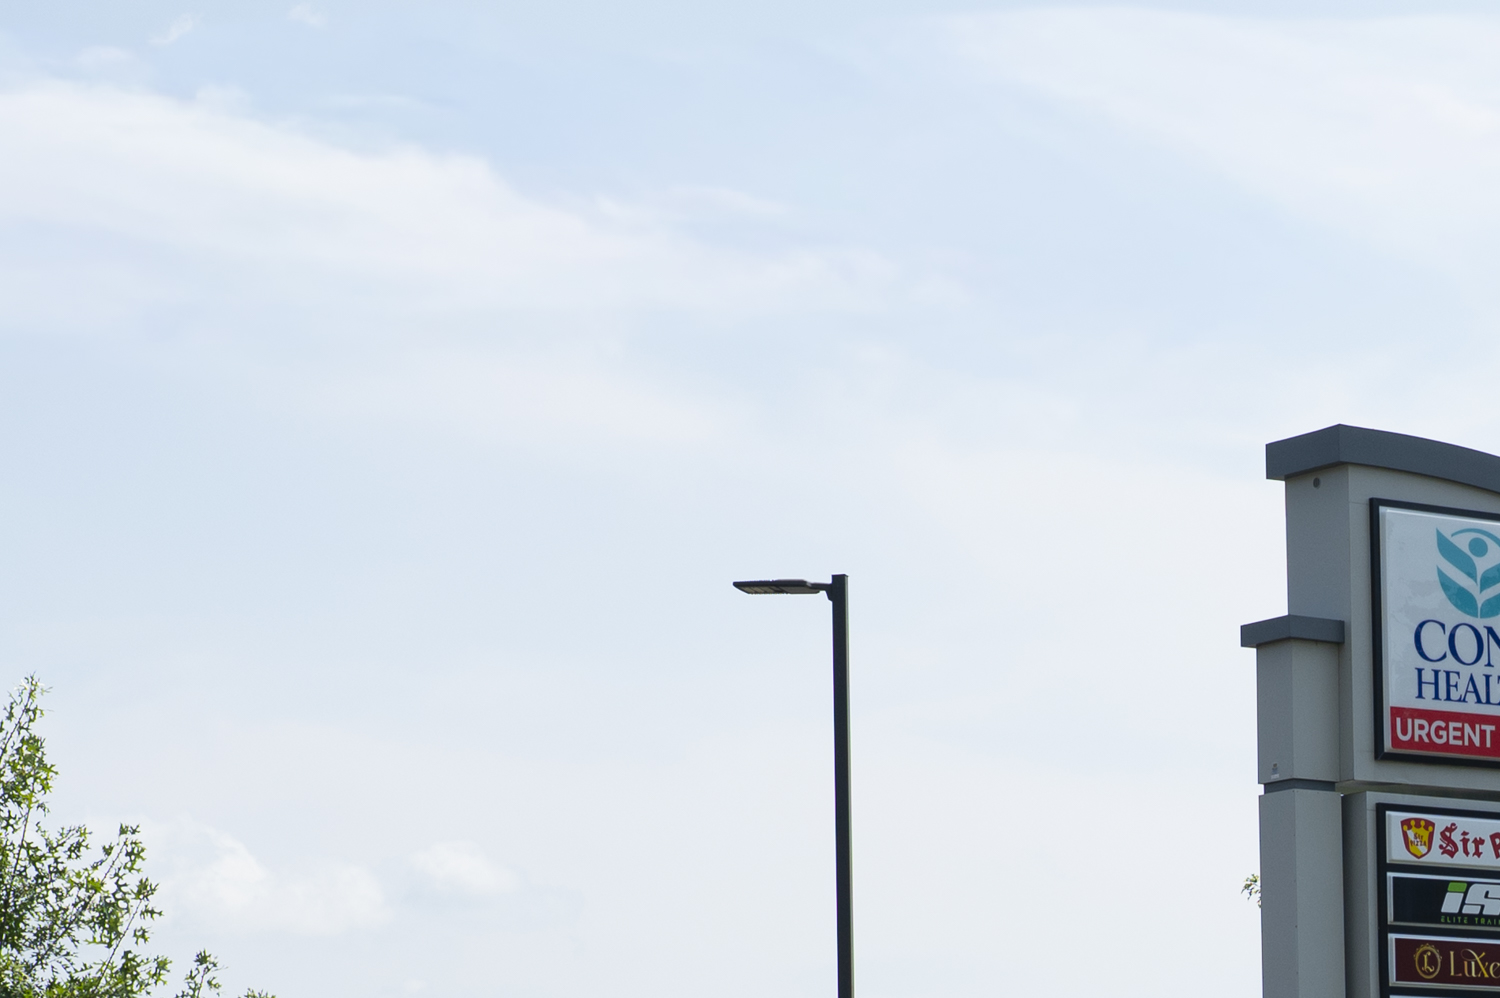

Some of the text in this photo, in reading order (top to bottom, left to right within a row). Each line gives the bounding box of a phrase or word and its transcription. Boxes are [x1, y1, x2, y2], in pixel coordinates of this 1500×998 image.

[1396, 717, 1495, 748] URGENT
[1439, 822, 1485, 859] Sir
[1441, 916, 1468, 924] ELITE
